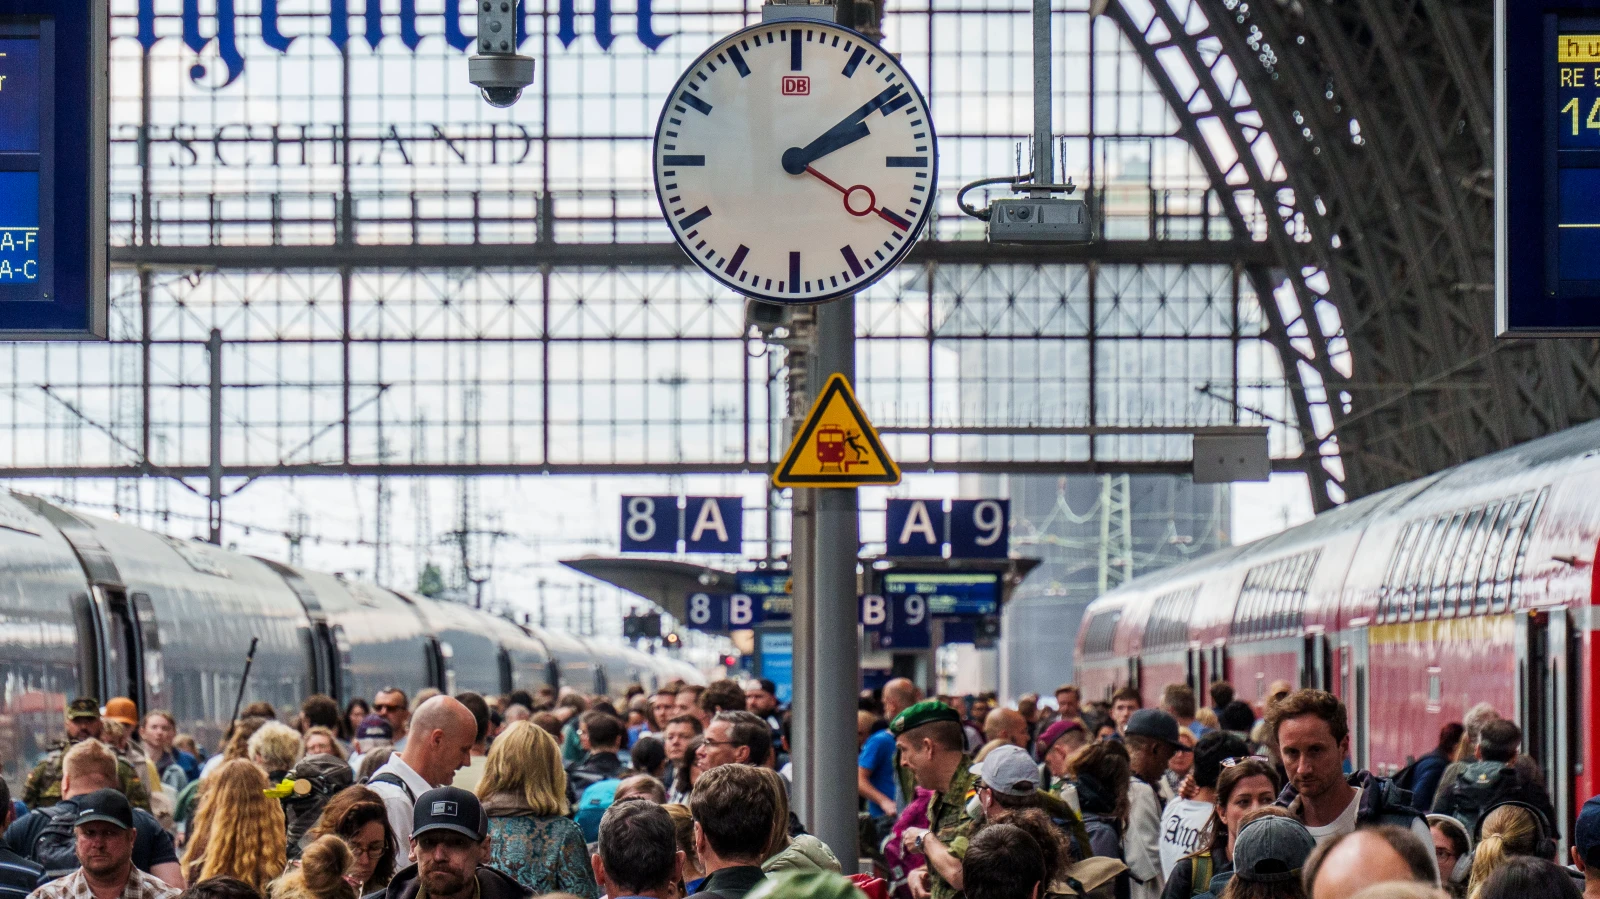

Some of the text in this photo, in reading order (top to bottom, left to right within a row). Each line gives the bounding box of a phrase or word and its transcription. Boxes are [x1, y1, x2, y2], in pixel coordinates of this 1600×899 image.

[784, 78, 808, 93] DB
[1561, 68, 1585, 87] RE
[1561, 97, 1600, 136] 14
[0, 232, 37, 251] A-F
[0, 259, 37, 279] A-C
[626, 497, 729, 542] 8 A
[898, 500, 1003, 546] A 9
[690, 593, 753, 625] 8 B
[863, 595, 887, 625] B
[904, 594, 925, 625] 9
